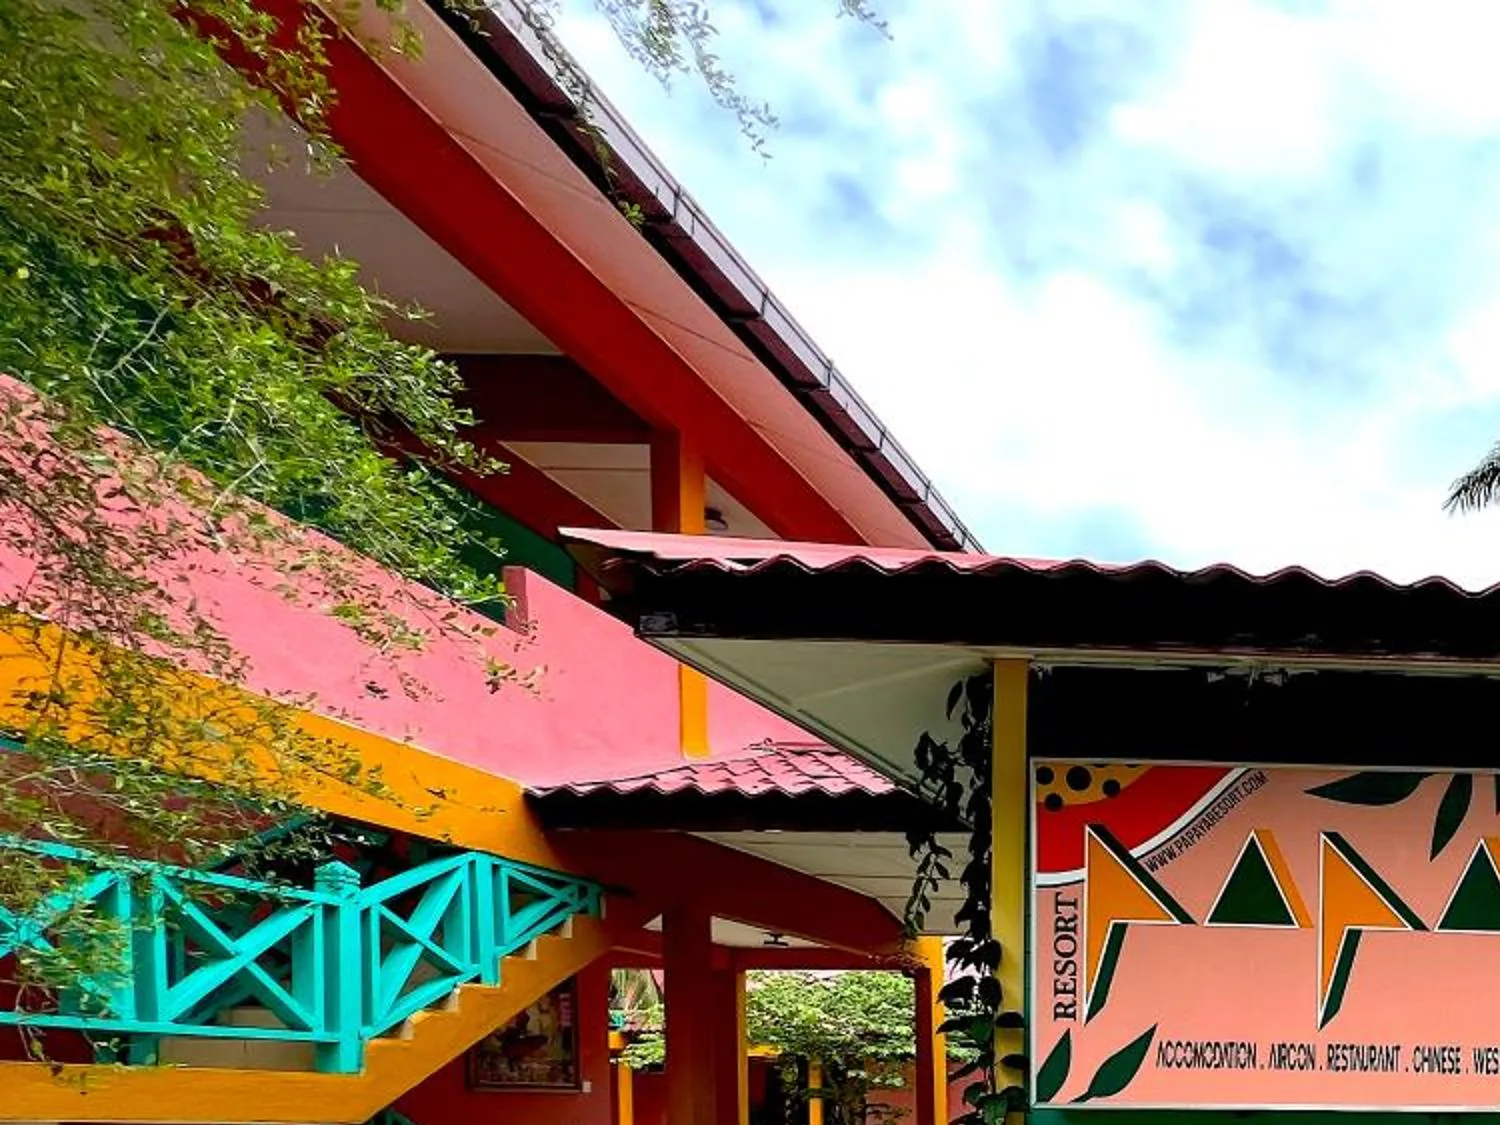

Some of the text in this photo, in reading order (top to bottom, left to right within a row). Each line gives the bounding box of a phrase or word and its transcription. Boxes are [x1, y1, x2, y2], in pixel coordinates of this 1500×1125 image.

[1145, 770, 1268, 873] WWW.PAPAYARESORT.COM
[1054, 892, 1078, 1021] RESORT
[1268, 1041, 1315, 1071] AIRCON
[1327, 1043, 1400, 1073] RESTAURANT
[1412, 1045, 1461, 1075] CHINESE
